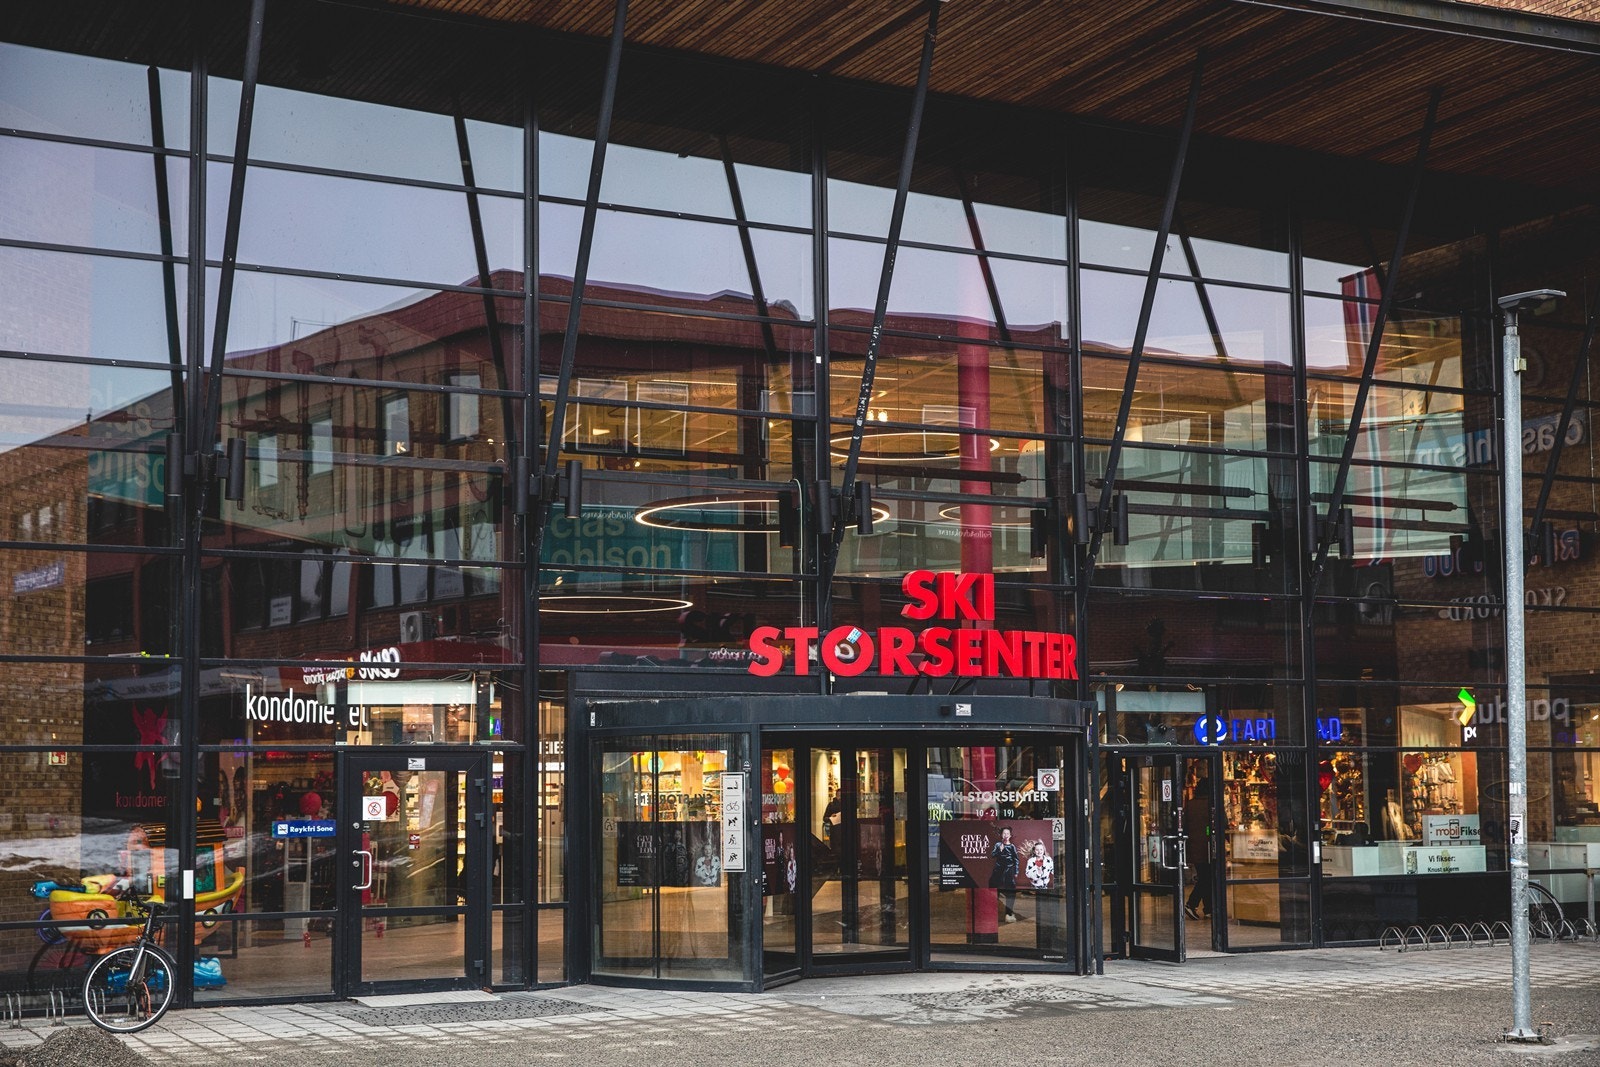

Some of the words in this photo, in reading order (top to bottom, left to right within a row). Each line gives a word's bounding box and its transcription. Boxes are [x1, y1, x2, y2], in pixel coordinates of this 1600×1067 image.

[902, 570, 995, 622] SKI
[747, 626, 1078, 680] STORSENTER
[943, 791, 963, 802] SKI
[967, 791, 1049, 802] STORSENTER
[975, 809, 984, 817] 10
[290, 825, 316, 833] Røykfri
[960, 834, 981, 842] GIVE
[982, 834, 990, 843] A
